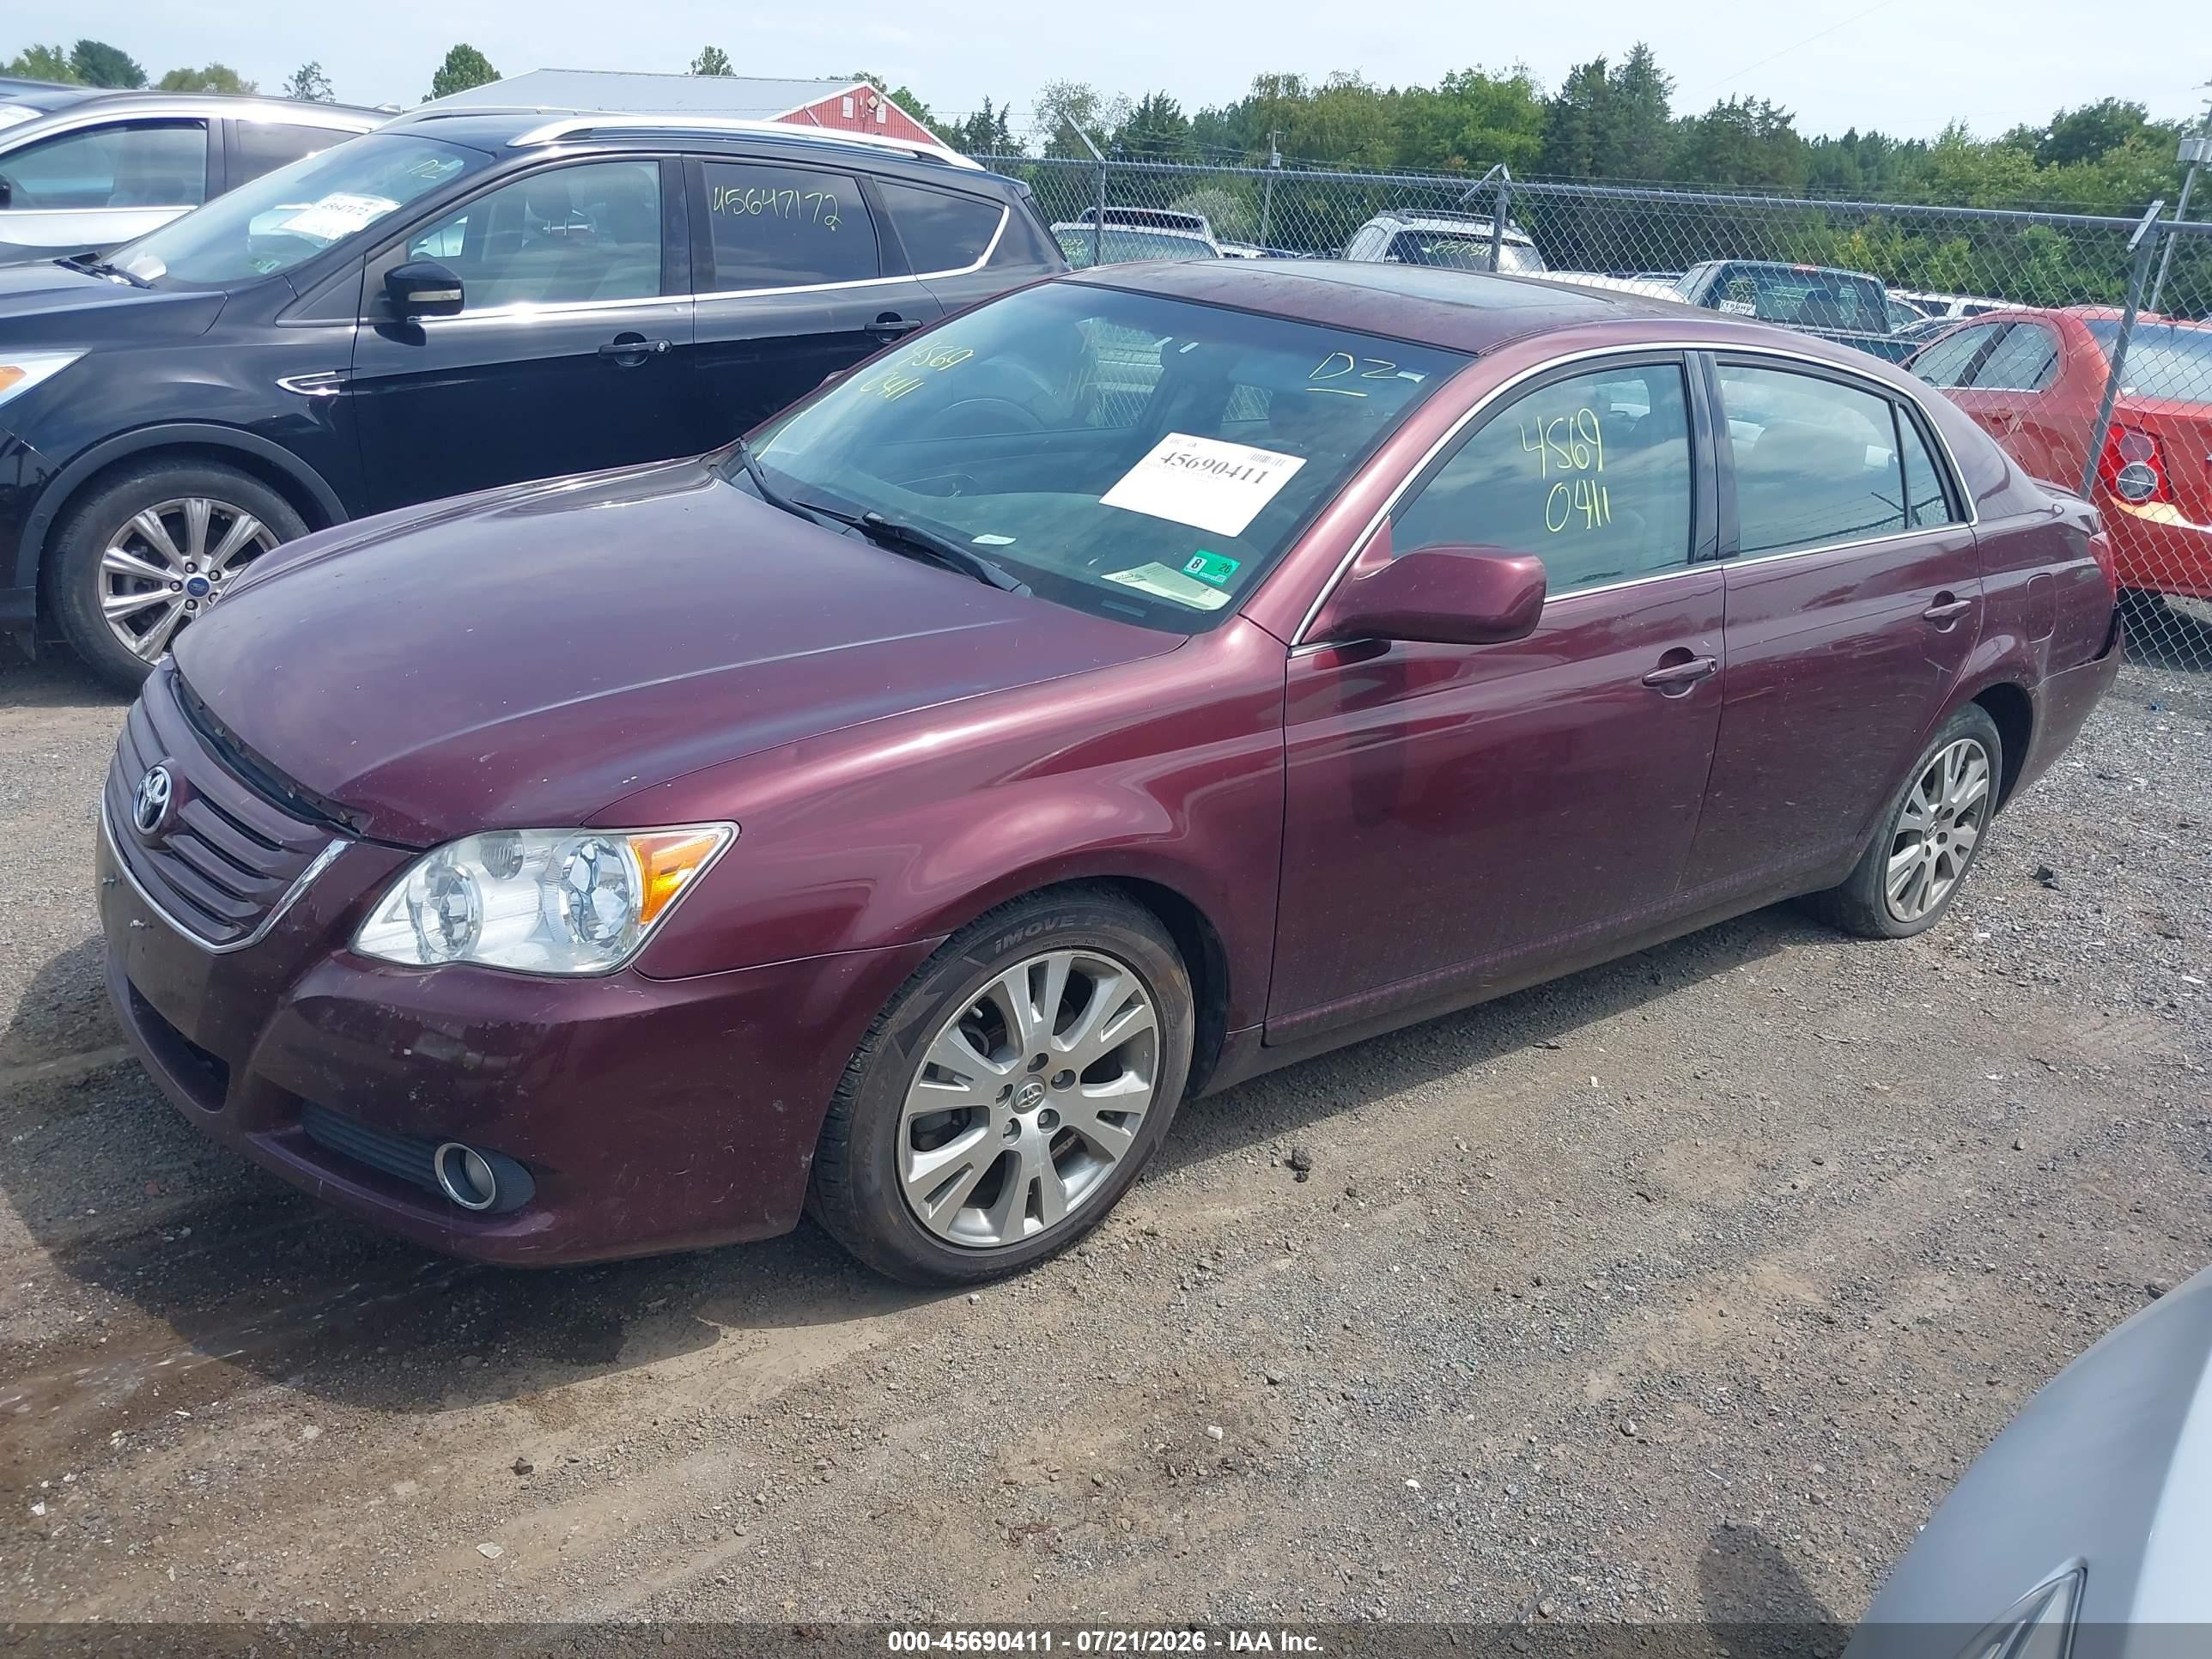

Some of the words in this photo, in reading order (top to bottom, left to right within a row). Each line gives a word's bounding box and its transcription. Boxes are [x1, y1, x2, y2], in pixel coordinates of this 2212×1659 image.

[713, 185, 842, 226] 45647172
[1519, 408, 1603, 481] 4569
[1161, 452, 1269, 483] 45690411
[1547, 478, 1612, 532] 0411
[1191, 558, 1203, 569] 8
[1218, 562, 1233, 574] 26
